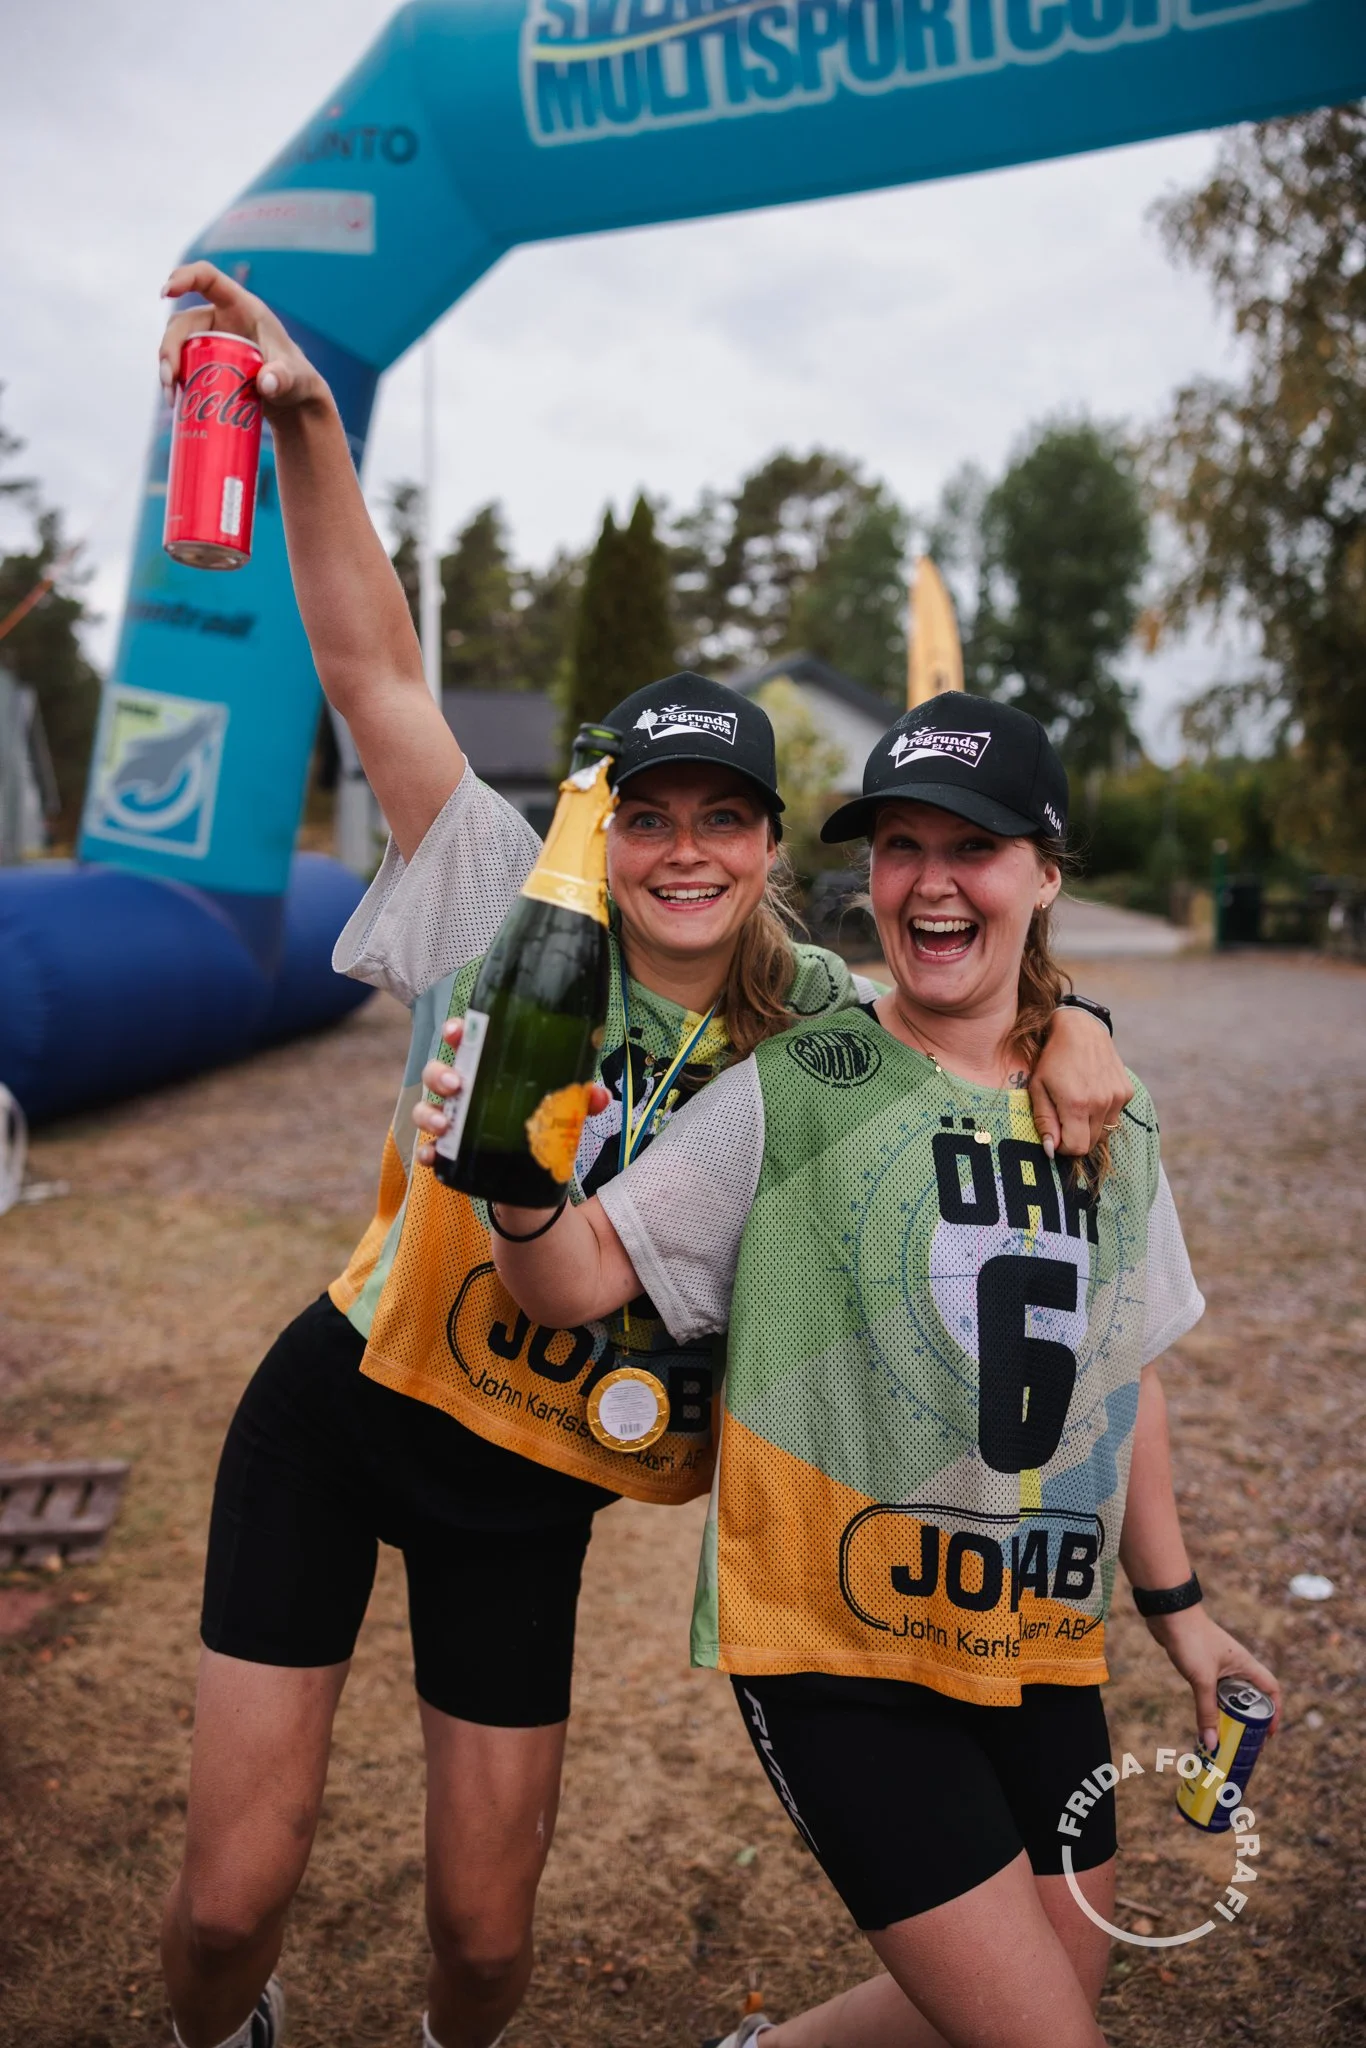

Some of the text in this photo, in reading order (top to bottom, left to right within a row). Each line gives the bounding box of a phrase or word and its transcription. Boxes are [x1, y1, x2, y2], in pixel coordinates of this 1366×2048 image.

[711, 724, 731, 735] VVS
[955, 746, 977, 757] VVS
[976, 1254, 1078, 1475] 6
[468, 1368, 523, 1406] John
[892, 1614, 948, 1648] John
[956, 1628, 1020, 1659] Karls
[1054, 1617, 1087, 1641] AB
